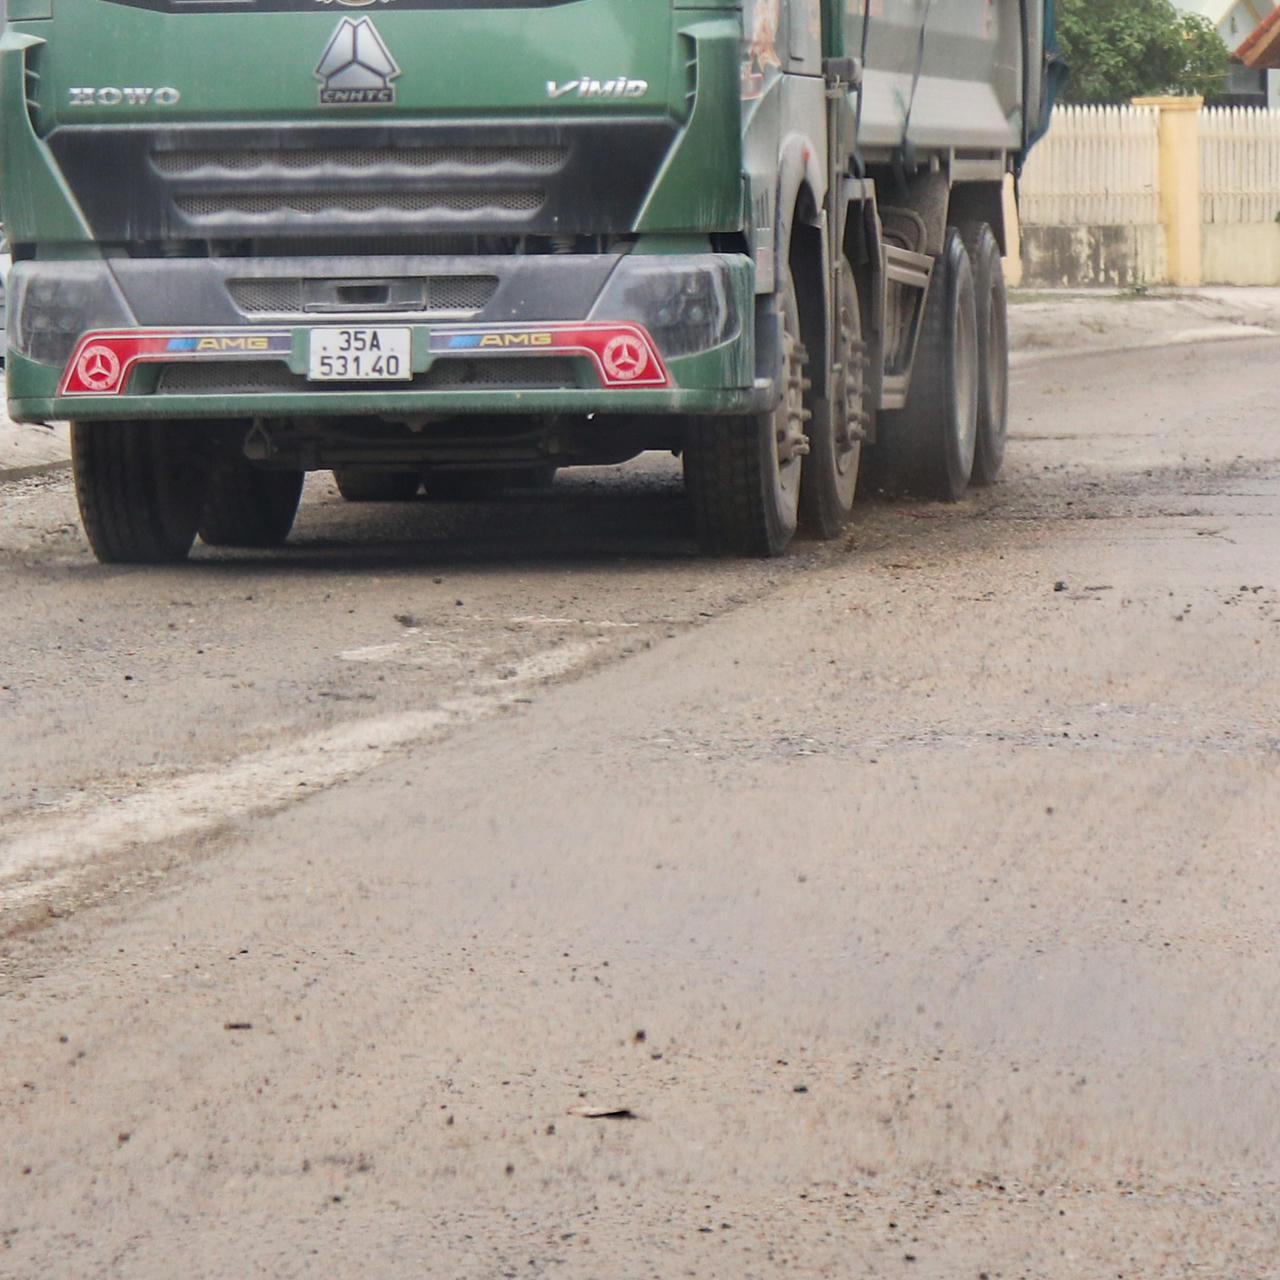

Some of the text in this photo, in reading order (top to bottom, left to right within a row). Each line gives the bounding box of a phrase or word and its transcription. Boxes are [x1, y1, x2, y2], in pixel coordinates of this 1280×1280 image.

[69, 86, 180, 106] HOWO
[322, 89, 392, 103] CNHTC
[196, 337, 268, 350] AMG
[339, 330, 381, 351] 35A
[479, 333, 552, 347] AMG
[320, 355, 399, 376] 531.40
